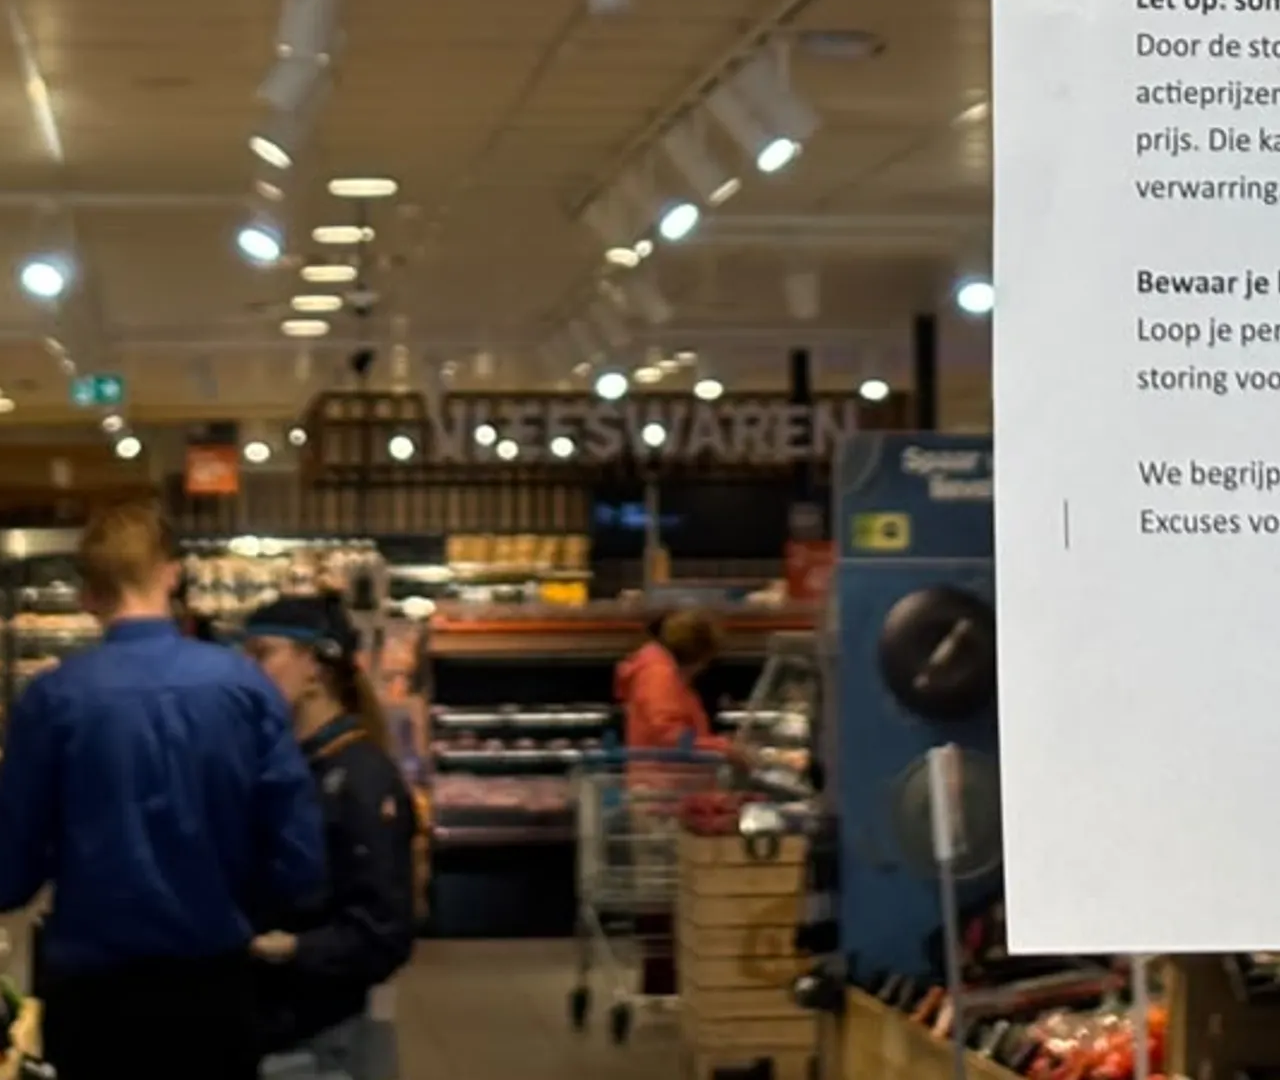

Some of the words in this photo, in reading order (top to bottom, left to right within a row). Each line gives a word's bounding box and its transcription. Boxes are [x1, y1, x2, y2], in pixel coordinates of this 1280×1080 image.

[1136, 32, 1202, 58] Door
[1208, 33, 1242, 59] de
[1136, 126, 1200, 158] prijs.
[1208, 127, 1252, 153] Die
[1136, 269, 1239, 295] Bewaar
[1243, 269, 1270, 301] je
[1137, 317, 1202, 348] Loop
[1207, 317, 1233, 349] je
[1137, 364, 1229, 397] storing
[1138, 461, 1183, 487] We
[1140, 508, 1242, 535] Excuses
